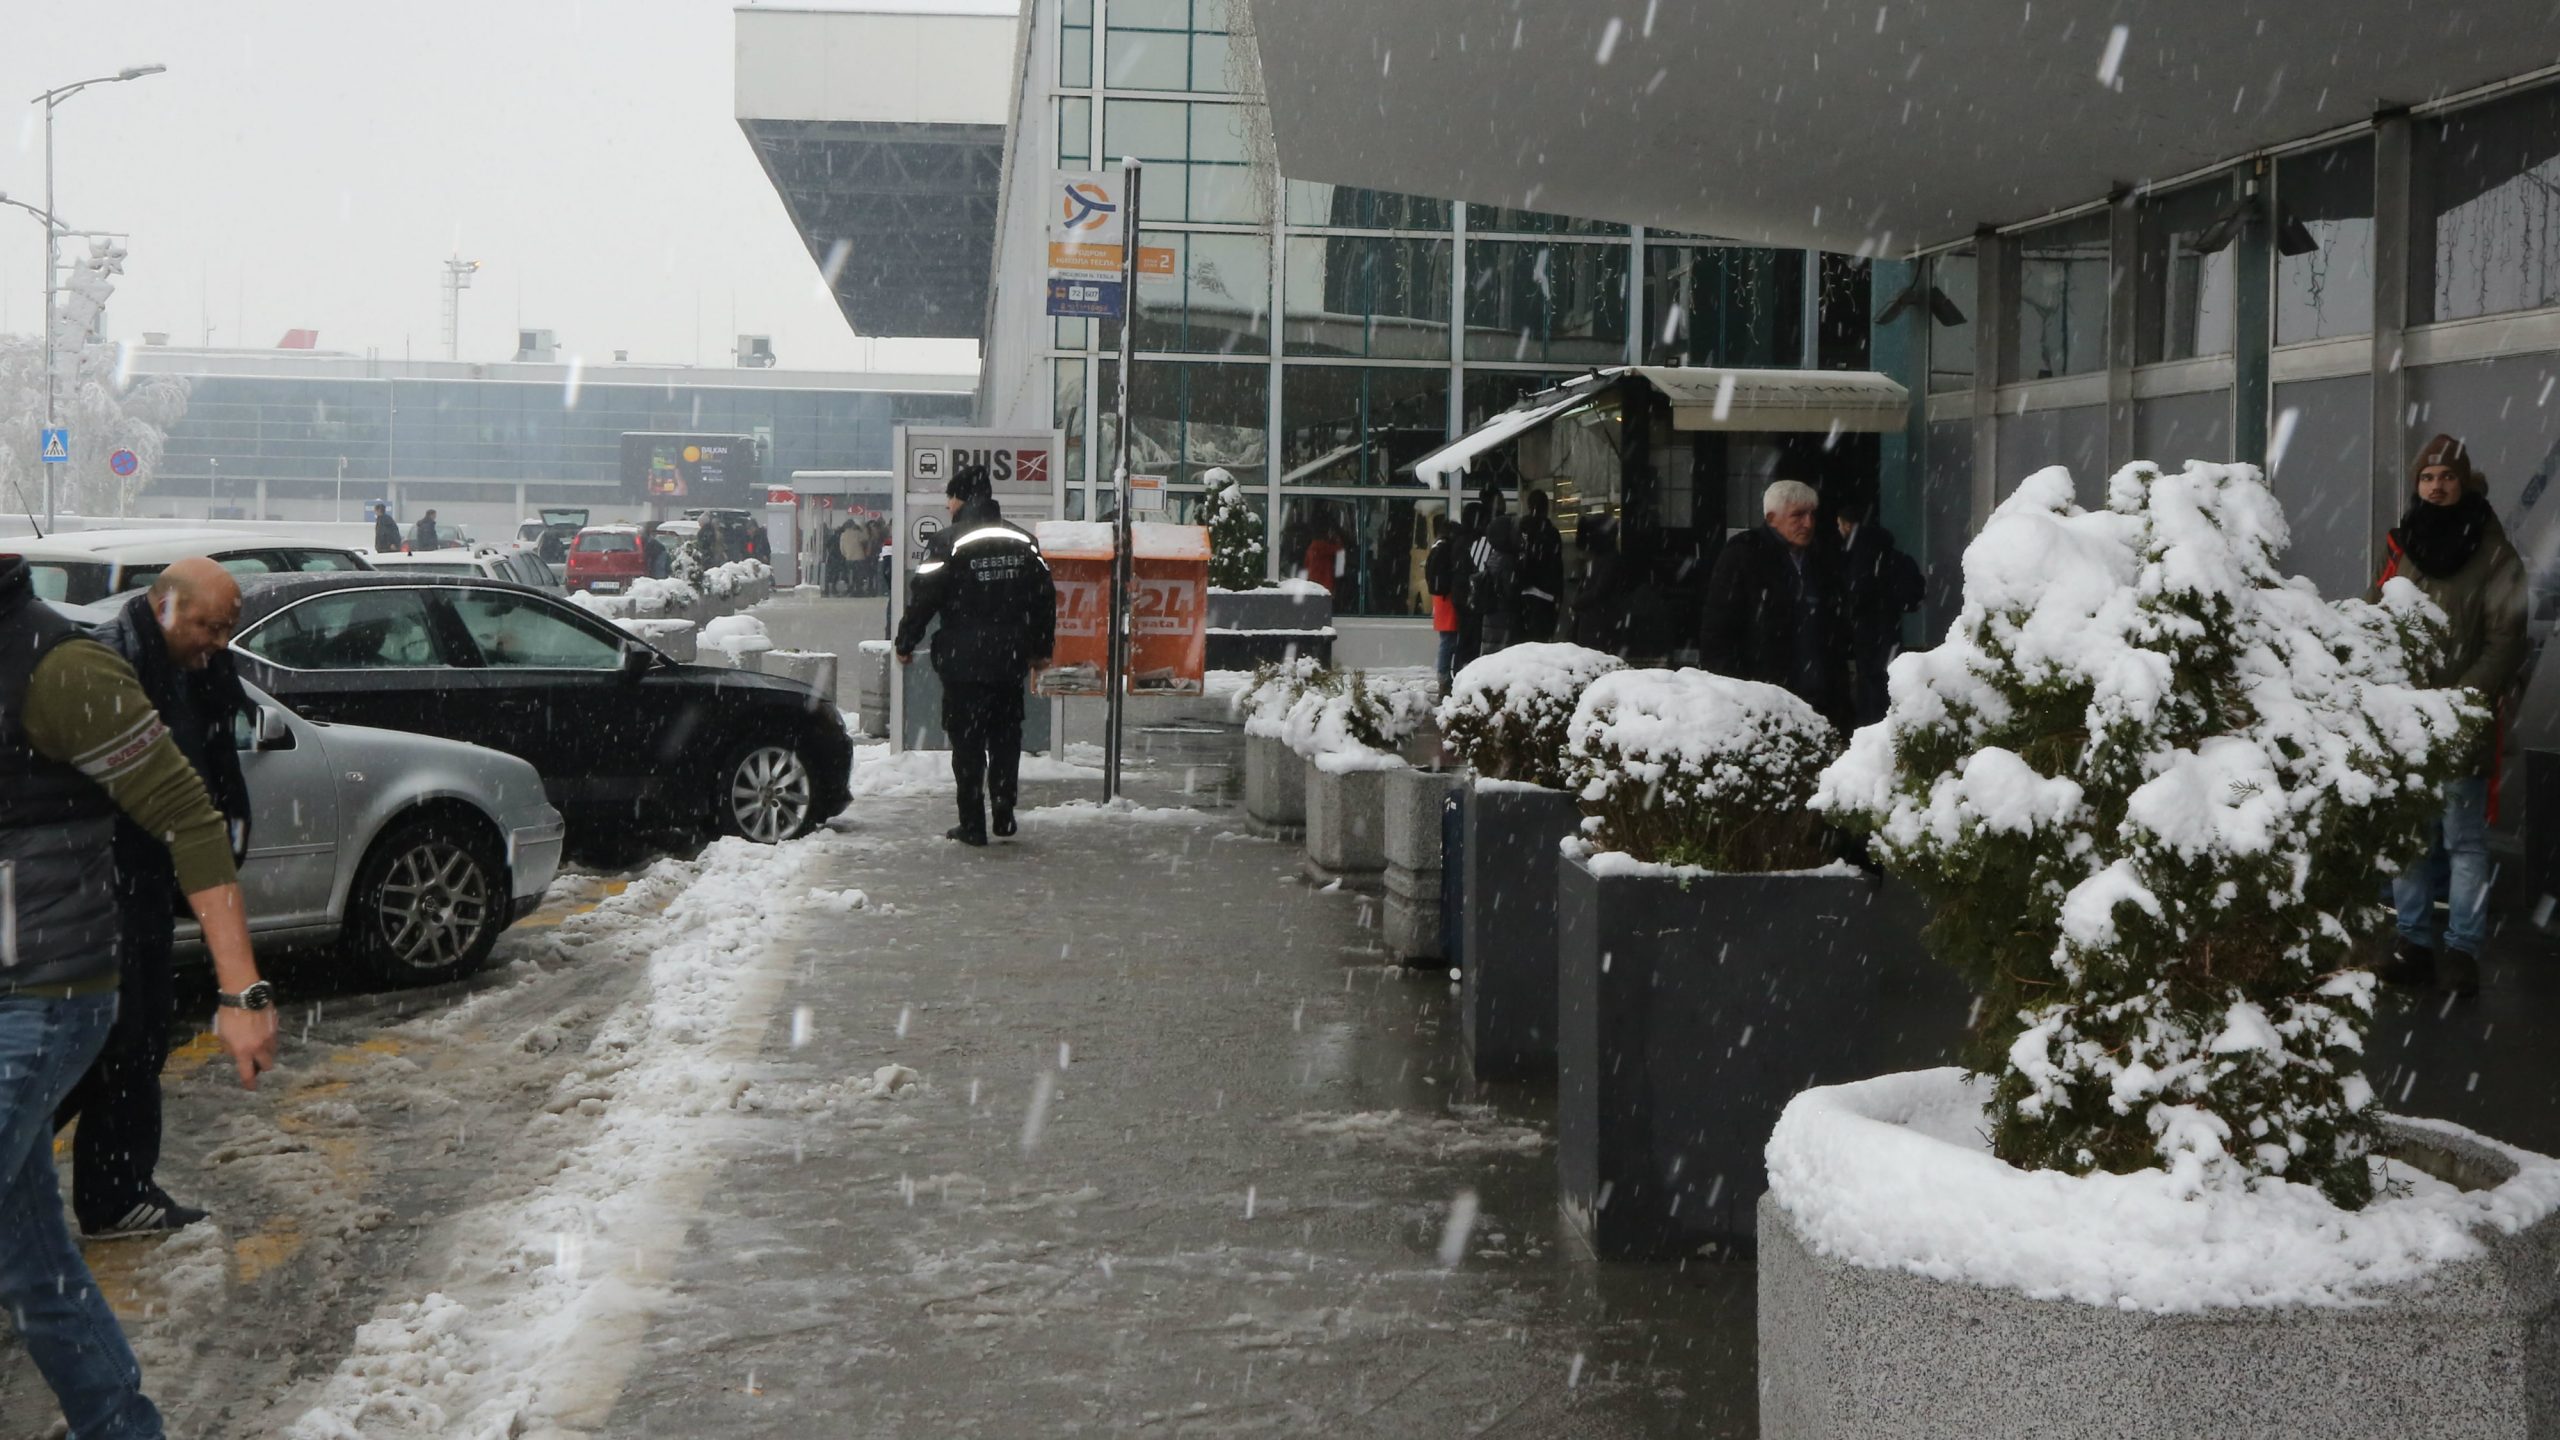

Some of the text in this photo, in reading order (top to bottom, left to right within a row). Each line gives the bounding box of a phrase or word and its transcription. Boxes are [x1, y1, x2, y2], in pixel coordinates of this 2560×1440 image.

[1090, 258, 1114, 266] ТЕСЛА
[1159, 254, 1170, 268] 2
[1085, 290, 1098, 298] 607
[952, 449, 1012, 481] BUS
[1135, 586, 1192, 628] 24
